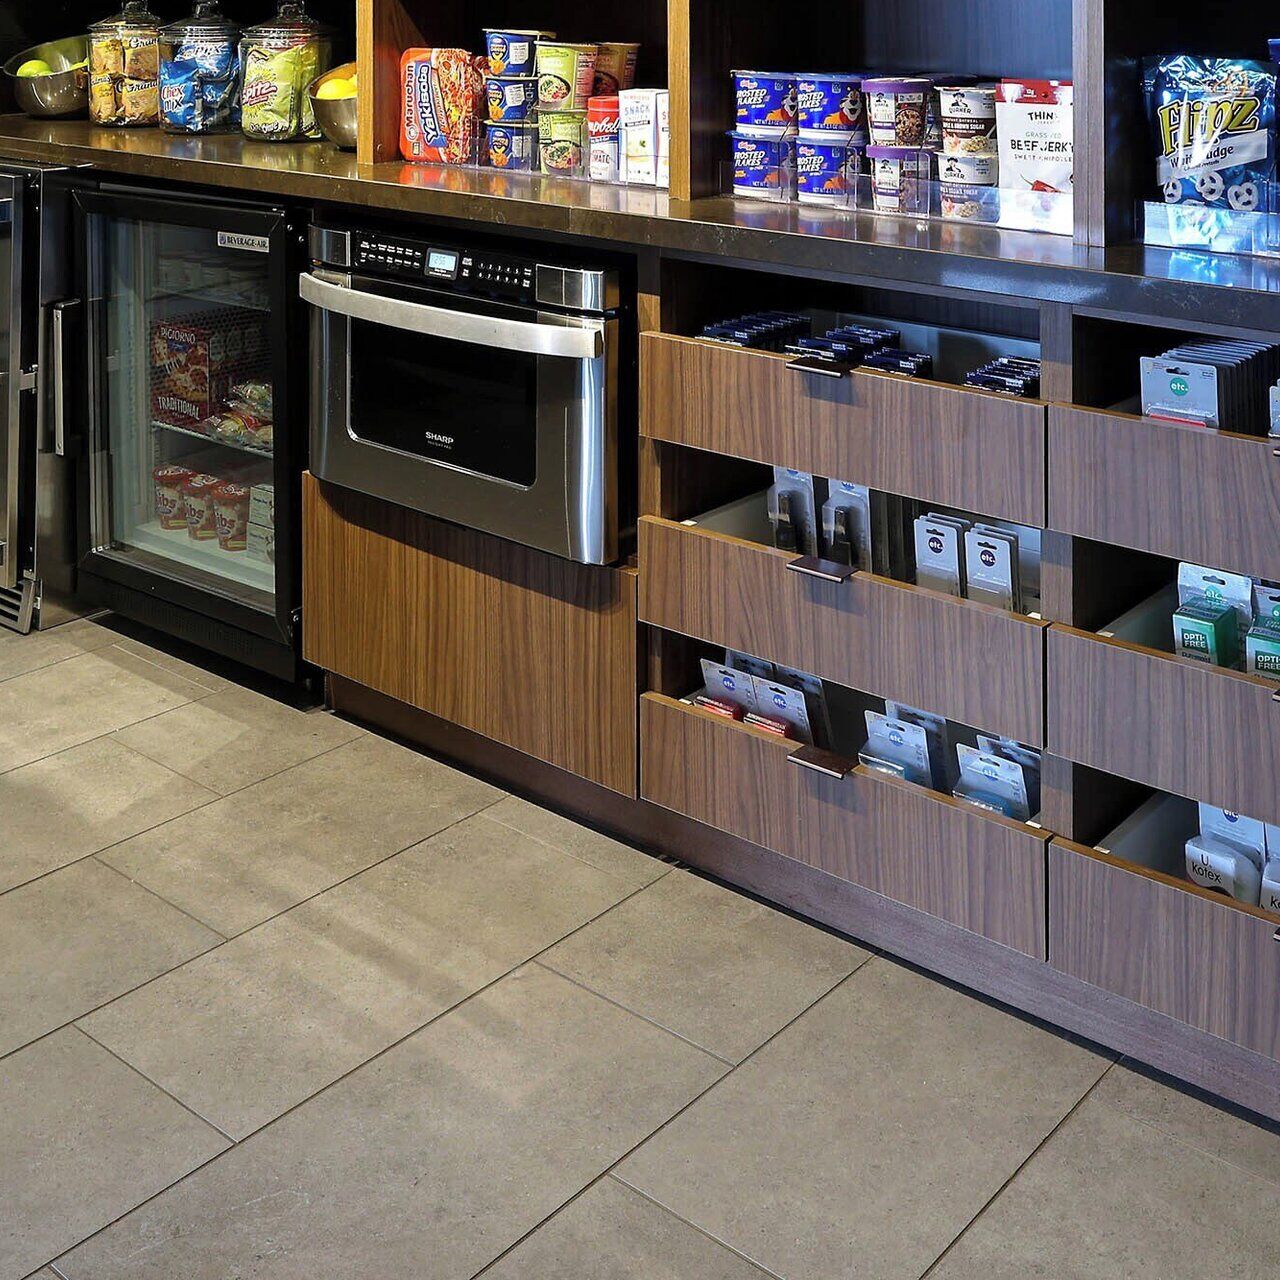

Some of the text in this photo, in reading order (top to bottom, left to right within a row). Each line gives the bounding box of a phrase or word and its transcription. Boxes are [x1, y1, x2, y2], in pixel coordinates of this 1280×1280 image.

[161, 85, 184, 100] Chex
[405, 65, 415, 126] Maruchan
[418, 64, 438, 144] Yakisoba
[1010, 140, 1038, 151] BEEF
[227, 235, 268, 249] BEVERAGE-AIR
[160, 327, 196, 344] DIGIORNO
[1170, 381, 1189, 392] etc.
[157, 395, 200, 420] TRADITIONAL
[426, 431, 454, 444] SHARP
[928, 540, 943, 550] etc.
[981, 553, 996, 563] etc.
[1192, 862, 1222, 884] kotex
